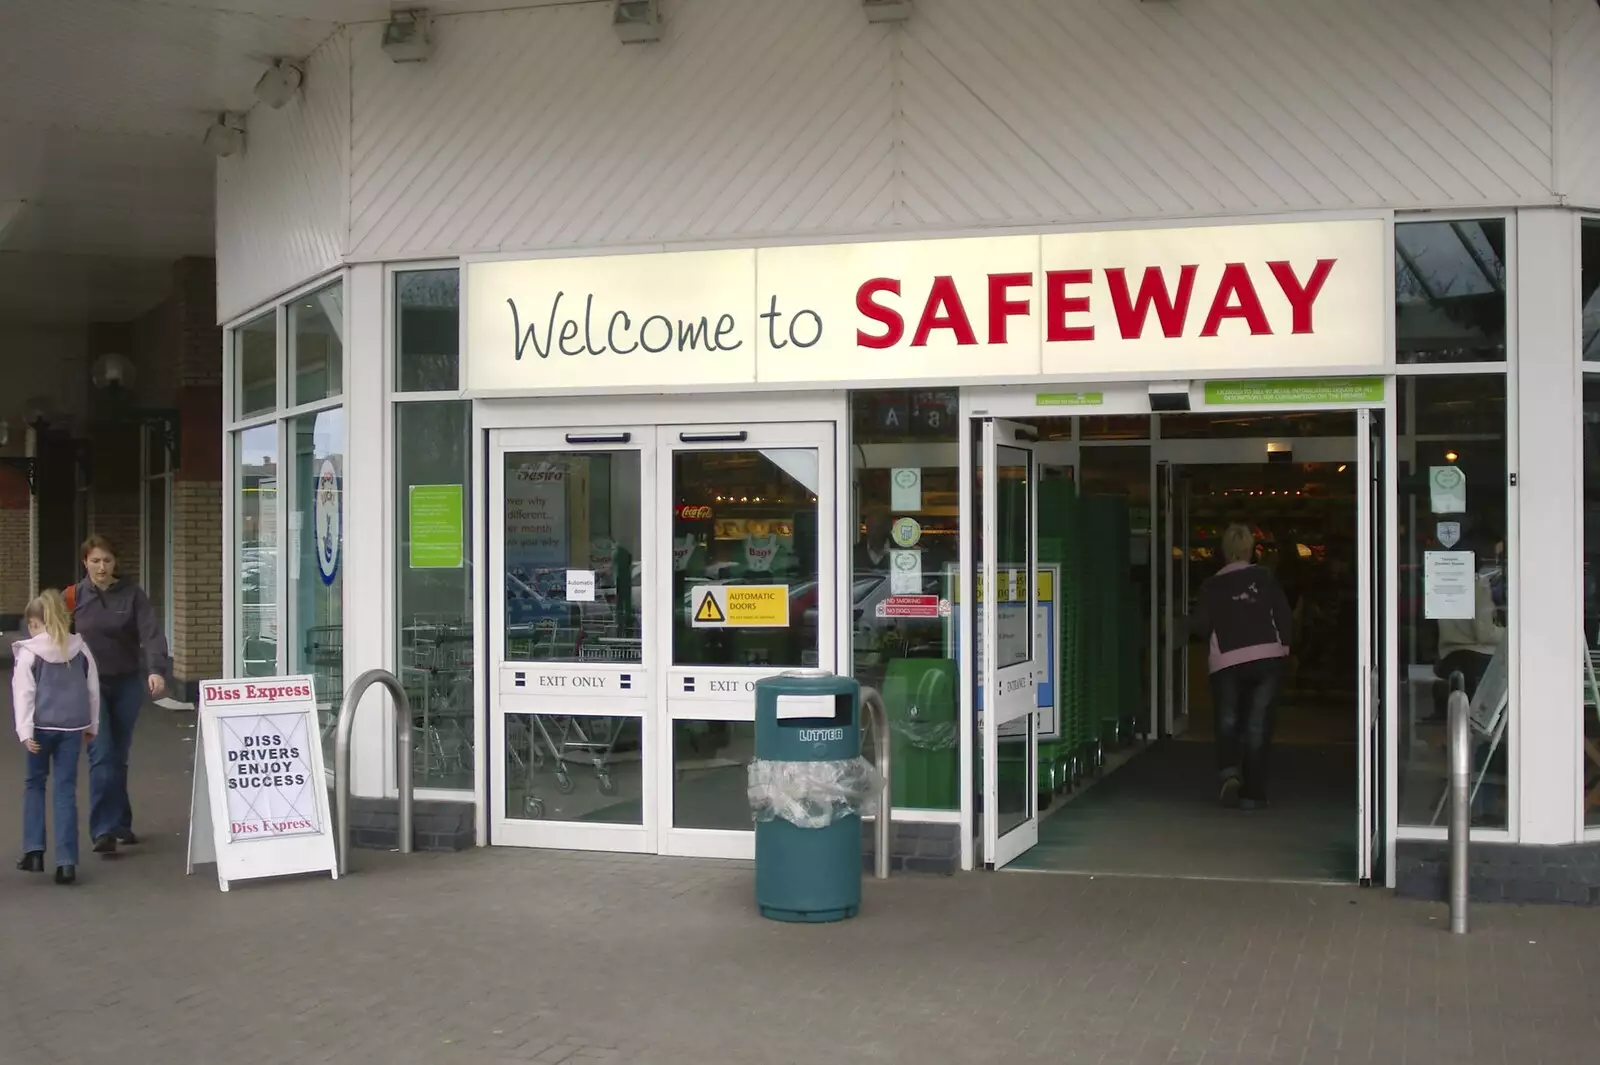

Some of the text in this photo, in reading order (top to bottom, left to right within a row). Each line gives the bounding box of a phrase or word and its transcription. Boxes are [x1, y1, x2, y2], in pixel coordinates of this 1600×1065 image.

[507, 259, 1337, 360] Welcome to SAFEWAY
[539, 676, 606, 688] EXIT ONLY
[710, 680, 739, 691] EXIT
[205, 684, 310, 701] Diss Express
[243, 735, 282, 747] DISS
[799, 728, 843, 741] LITTER
[228, 748, 300, 762] DRIVERS
[238, 762, 292, 775] ENJOY
[228, 774, 305, 789] SUCCESS
[231, 818, 312, 834] Diss Express
